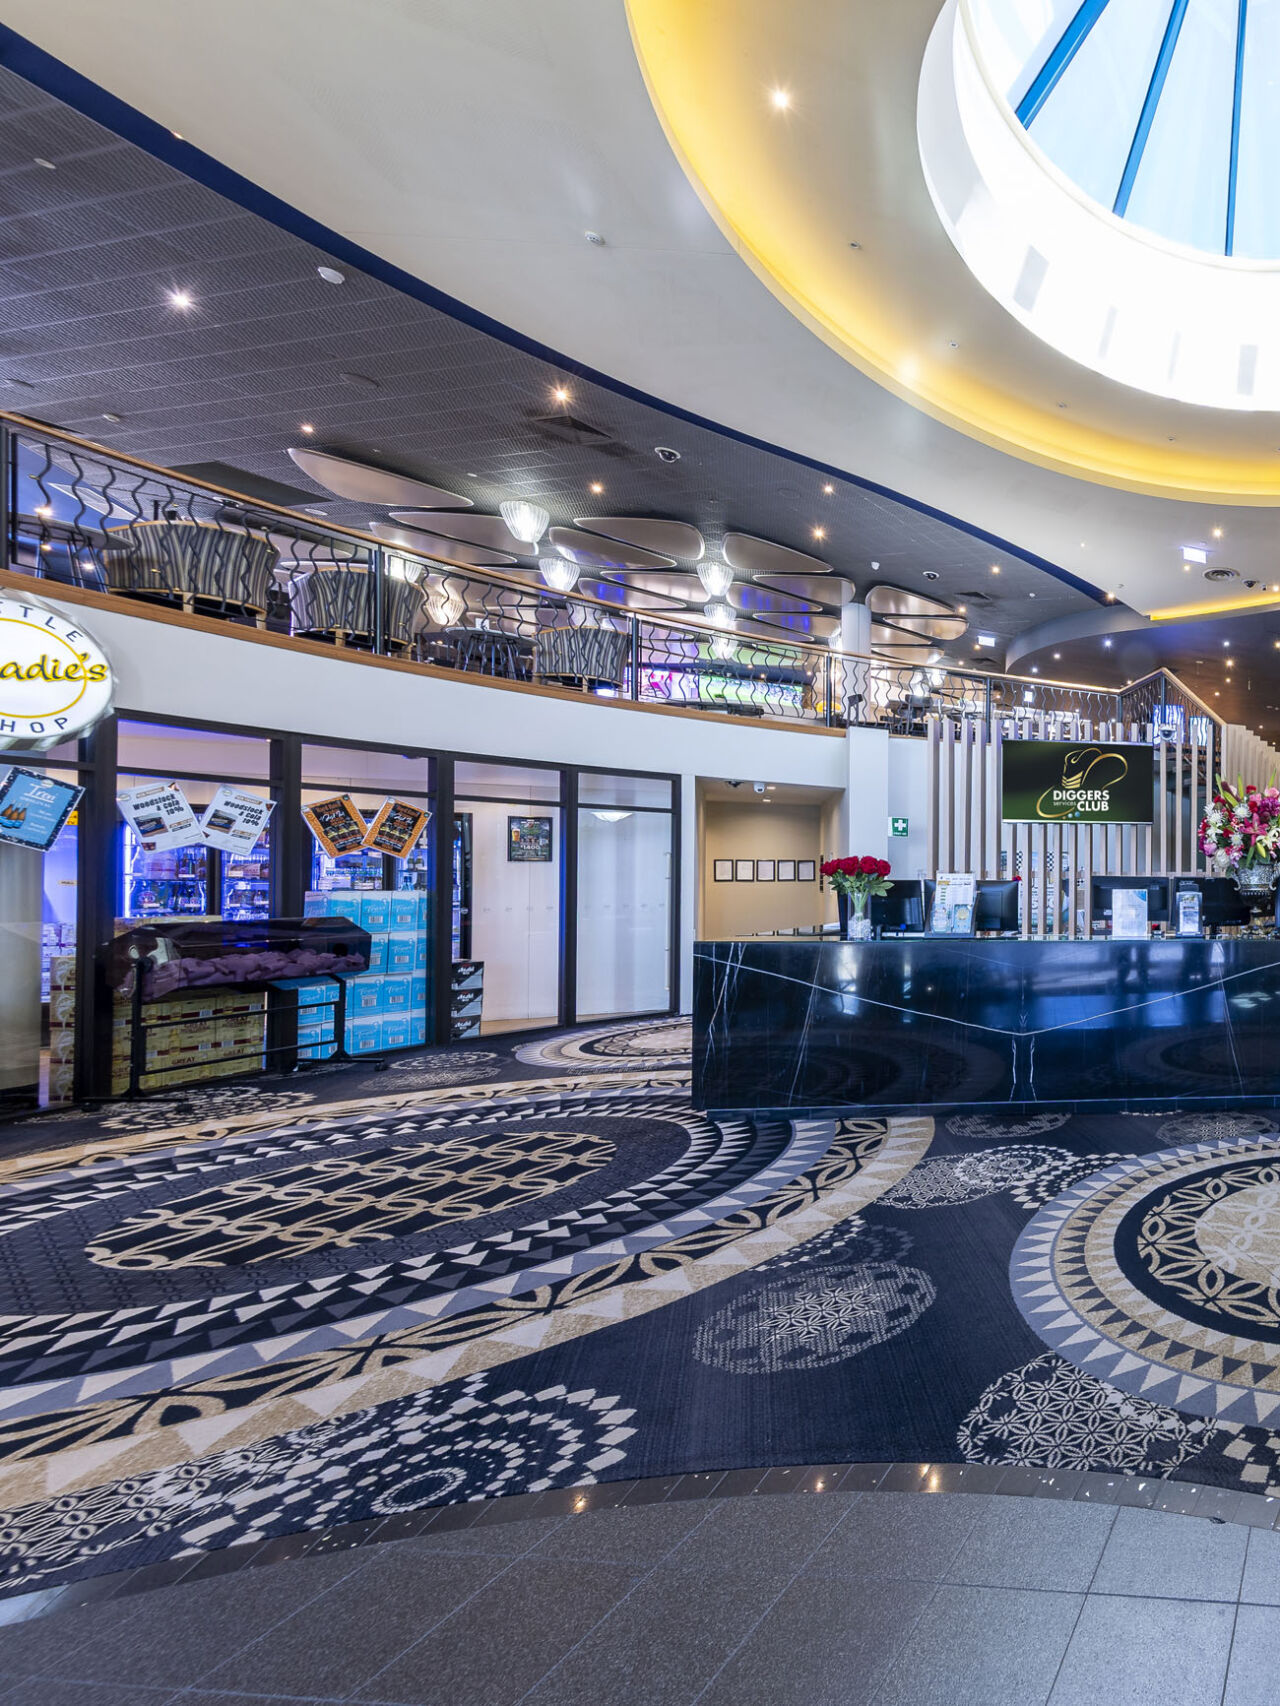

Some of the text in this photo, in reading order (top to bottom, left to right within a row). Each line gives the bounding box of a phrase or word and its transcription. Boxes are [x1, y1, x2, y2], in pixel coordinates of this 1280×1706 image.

[0, 602, 84, 643] TLE
[1053, 790, 1110, 801] DIGGERS
[166, 806, 184, 816] 10%
[1077, 801, 1110, 812] CLUB
